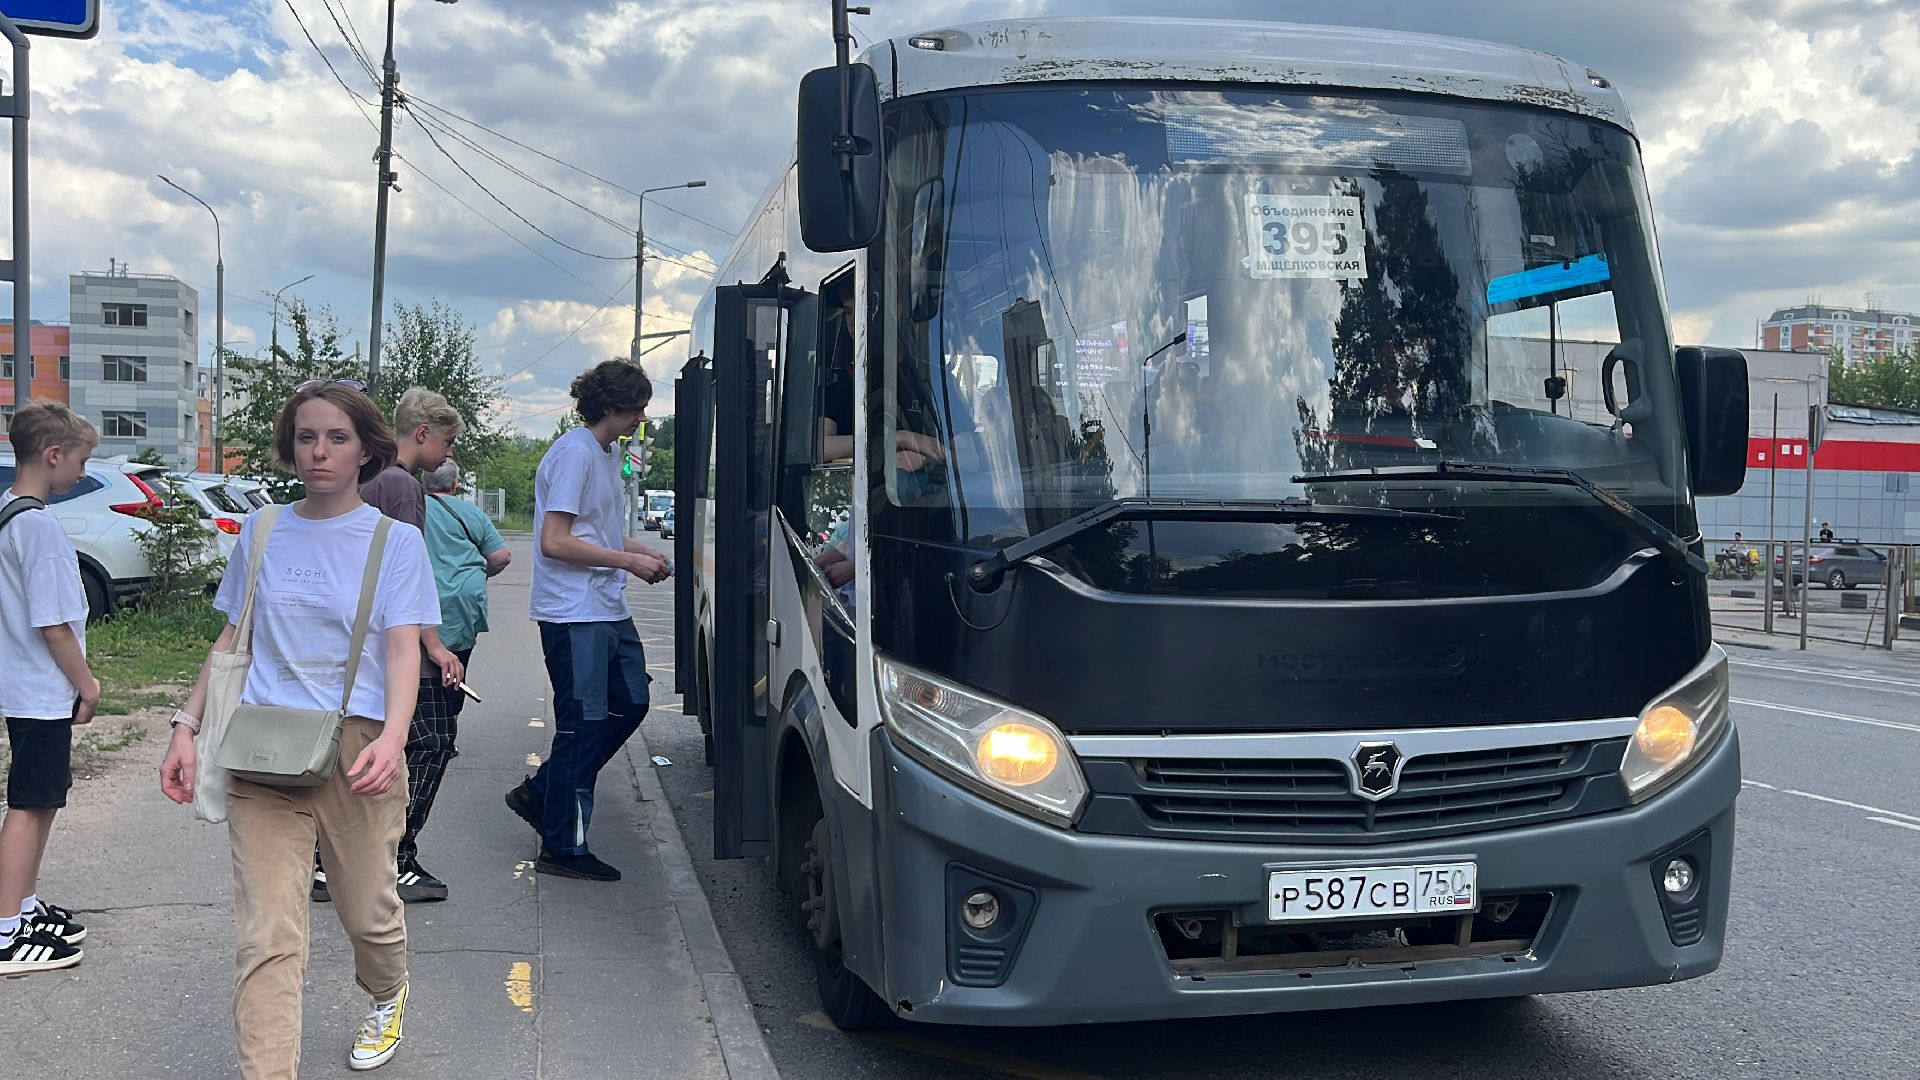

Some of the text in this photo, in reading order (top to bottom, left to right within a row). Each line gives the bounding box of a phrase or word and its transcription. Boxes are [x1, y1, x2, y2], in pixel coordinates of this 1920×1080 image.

[1251, 206, 1354, 217] Объединение
[1263, 222, 1348, 255] 395
[286, 568, 327, 578] SOCHI
[1419, 870, 1466, 896] 750
[1430, 896, 1453, 906] RUS
